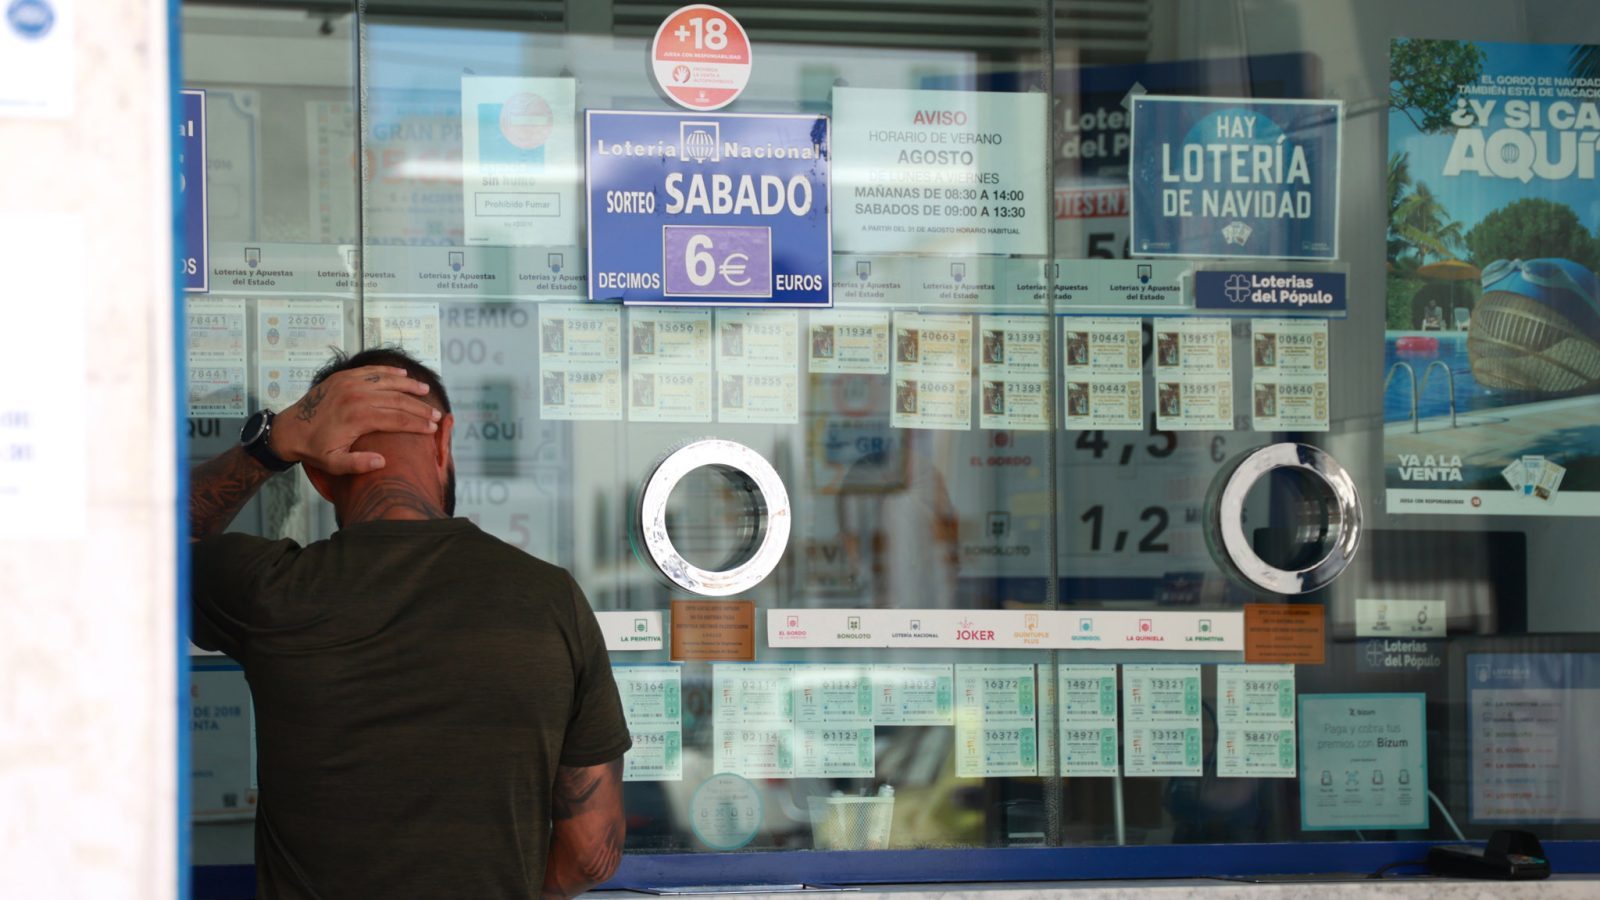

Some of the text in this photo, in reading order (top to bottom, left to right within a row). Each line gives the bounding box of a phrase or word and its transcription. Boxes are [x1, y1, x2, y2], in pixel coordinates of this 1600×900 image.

[674, 17, 728, 50] +18
[1481, 75, 1494, 84] EL
[1497, 76, 1536, 86] GORDO
[1538, 76, 1552, 86] DE
[1457, 84, 1506, 96] TAMBIÉN
[1508, 85, 1536, 96] ESTÁ
[1539, 86, 1554, 97] DE
[913, 111, 967, 126] AVISO
[1451, 98, 1600, 130] ¿Y SI CA
[1217, 116, 1256, 138] HAY
[869, 131, 1002, 145] HORARIO DE VERANO
[598, 140, 820, 160] Lotería Nacional
[898, 150, 973, 166] AGOSTO
[1162, 134, 1311, 184] LOTERÍA
[1442, 128, 1600, 185] AQUÍ
[946, 172, 1000, 185] VIERNES
[607, 173, 813, 216] SORTEO SABADO
[854, 185, 1024, 201] MAÑANAS DE 08:30 A 14:00
[484, 200, 551, 209] Prohibido Fumar
[1163, 189, 1311, 218] DE NAVIDAD
[855, 204, 1026, 218] SABADOS DE 09:00 A 13:30
[460, 273, 496, 281] Apuestas
[599, 272, 661, 289] DECIMOS
[776, 274, 823, 291] EUROS
[336, 280, 348, 288] del
[451, 282, 479, 290] Estado
[868, 282, 901, 290] Apuestas
[961, 283, 996, 292] Apuestas
[1148, 284, 1181, 293] Apuestas
[953, 292, 979, 300] Estado
[1252, 290, 1334, 307] del Pópulo
[659, 323, 694, 333] 15656
[838, 327, 873, 336] 11934
[921, 332, 956, 341] 40663
[1007, 333, 1042, 342] 21393
[1092, 334, 1126, 343] 90442
[1182, 334, 1215, 343] 15951
[1278, 335, 1313, 344] 00540
[1007, 384, 1042, 392] 21393
[1092, 384, 1127, 393] 90442
[1183, 384, 1216, 393] 15951
[1279, 385, 1313, 394] 00540
[986, 456, 1032, 466] GORDO
[1398, 454, 1464, 467] YA A LA
[1398, 468, 1464, 482] VENTA
[1080, 504, 1170, 552] 1,2
[956, 630, 995, 641] JOKER
[1385, 655, 1402, 666] del
[629, 682, 664, 692] 15164
[985, 680, 1018, 689] 16372
[1067, 680, 1100, 689] 14971
[1151, 680, 1184, 689] 13121
[1246, 682, 1280, 691] 58470
[1324, 723, 1348, 734] Paga
[1358, 724, 1384, 734] cobra
[1386, 724, 1402, 733] tus
[823, 732, 858, 740] 61123
[986, 732, 1019, 740] 16372
[1067, 731, 1100, 740] 14971
[1152, 731, 1185, 740] 13121
[1246, 733, 1280, 742] 58470
[1317, 737, 1408, 750] premios con Bizum
